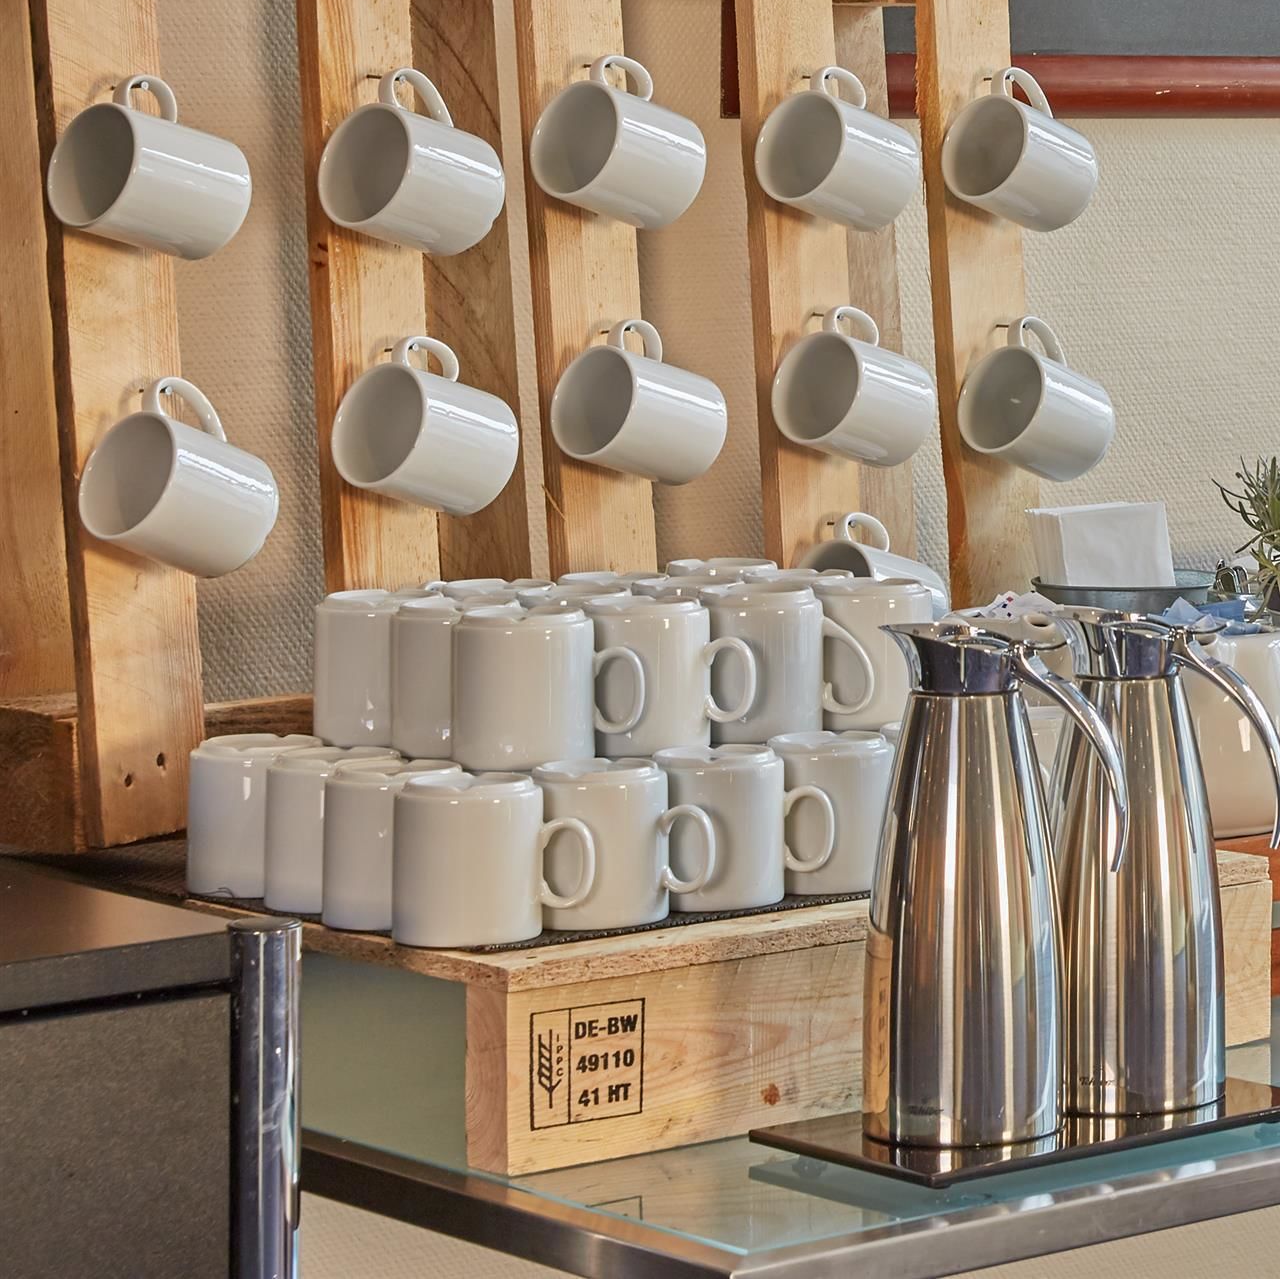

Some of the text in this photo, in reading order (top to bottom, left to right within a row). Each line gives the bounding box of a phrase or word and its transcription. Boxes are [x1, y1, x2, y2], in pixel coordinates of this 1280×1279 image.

[574, 1014, 638, 1040] DE-BW
[556, 1034, 564, 1077] IPPC
[576, 1048, 635, 1073] 49110
[578, 1083, 632, 1107] 41 HT
